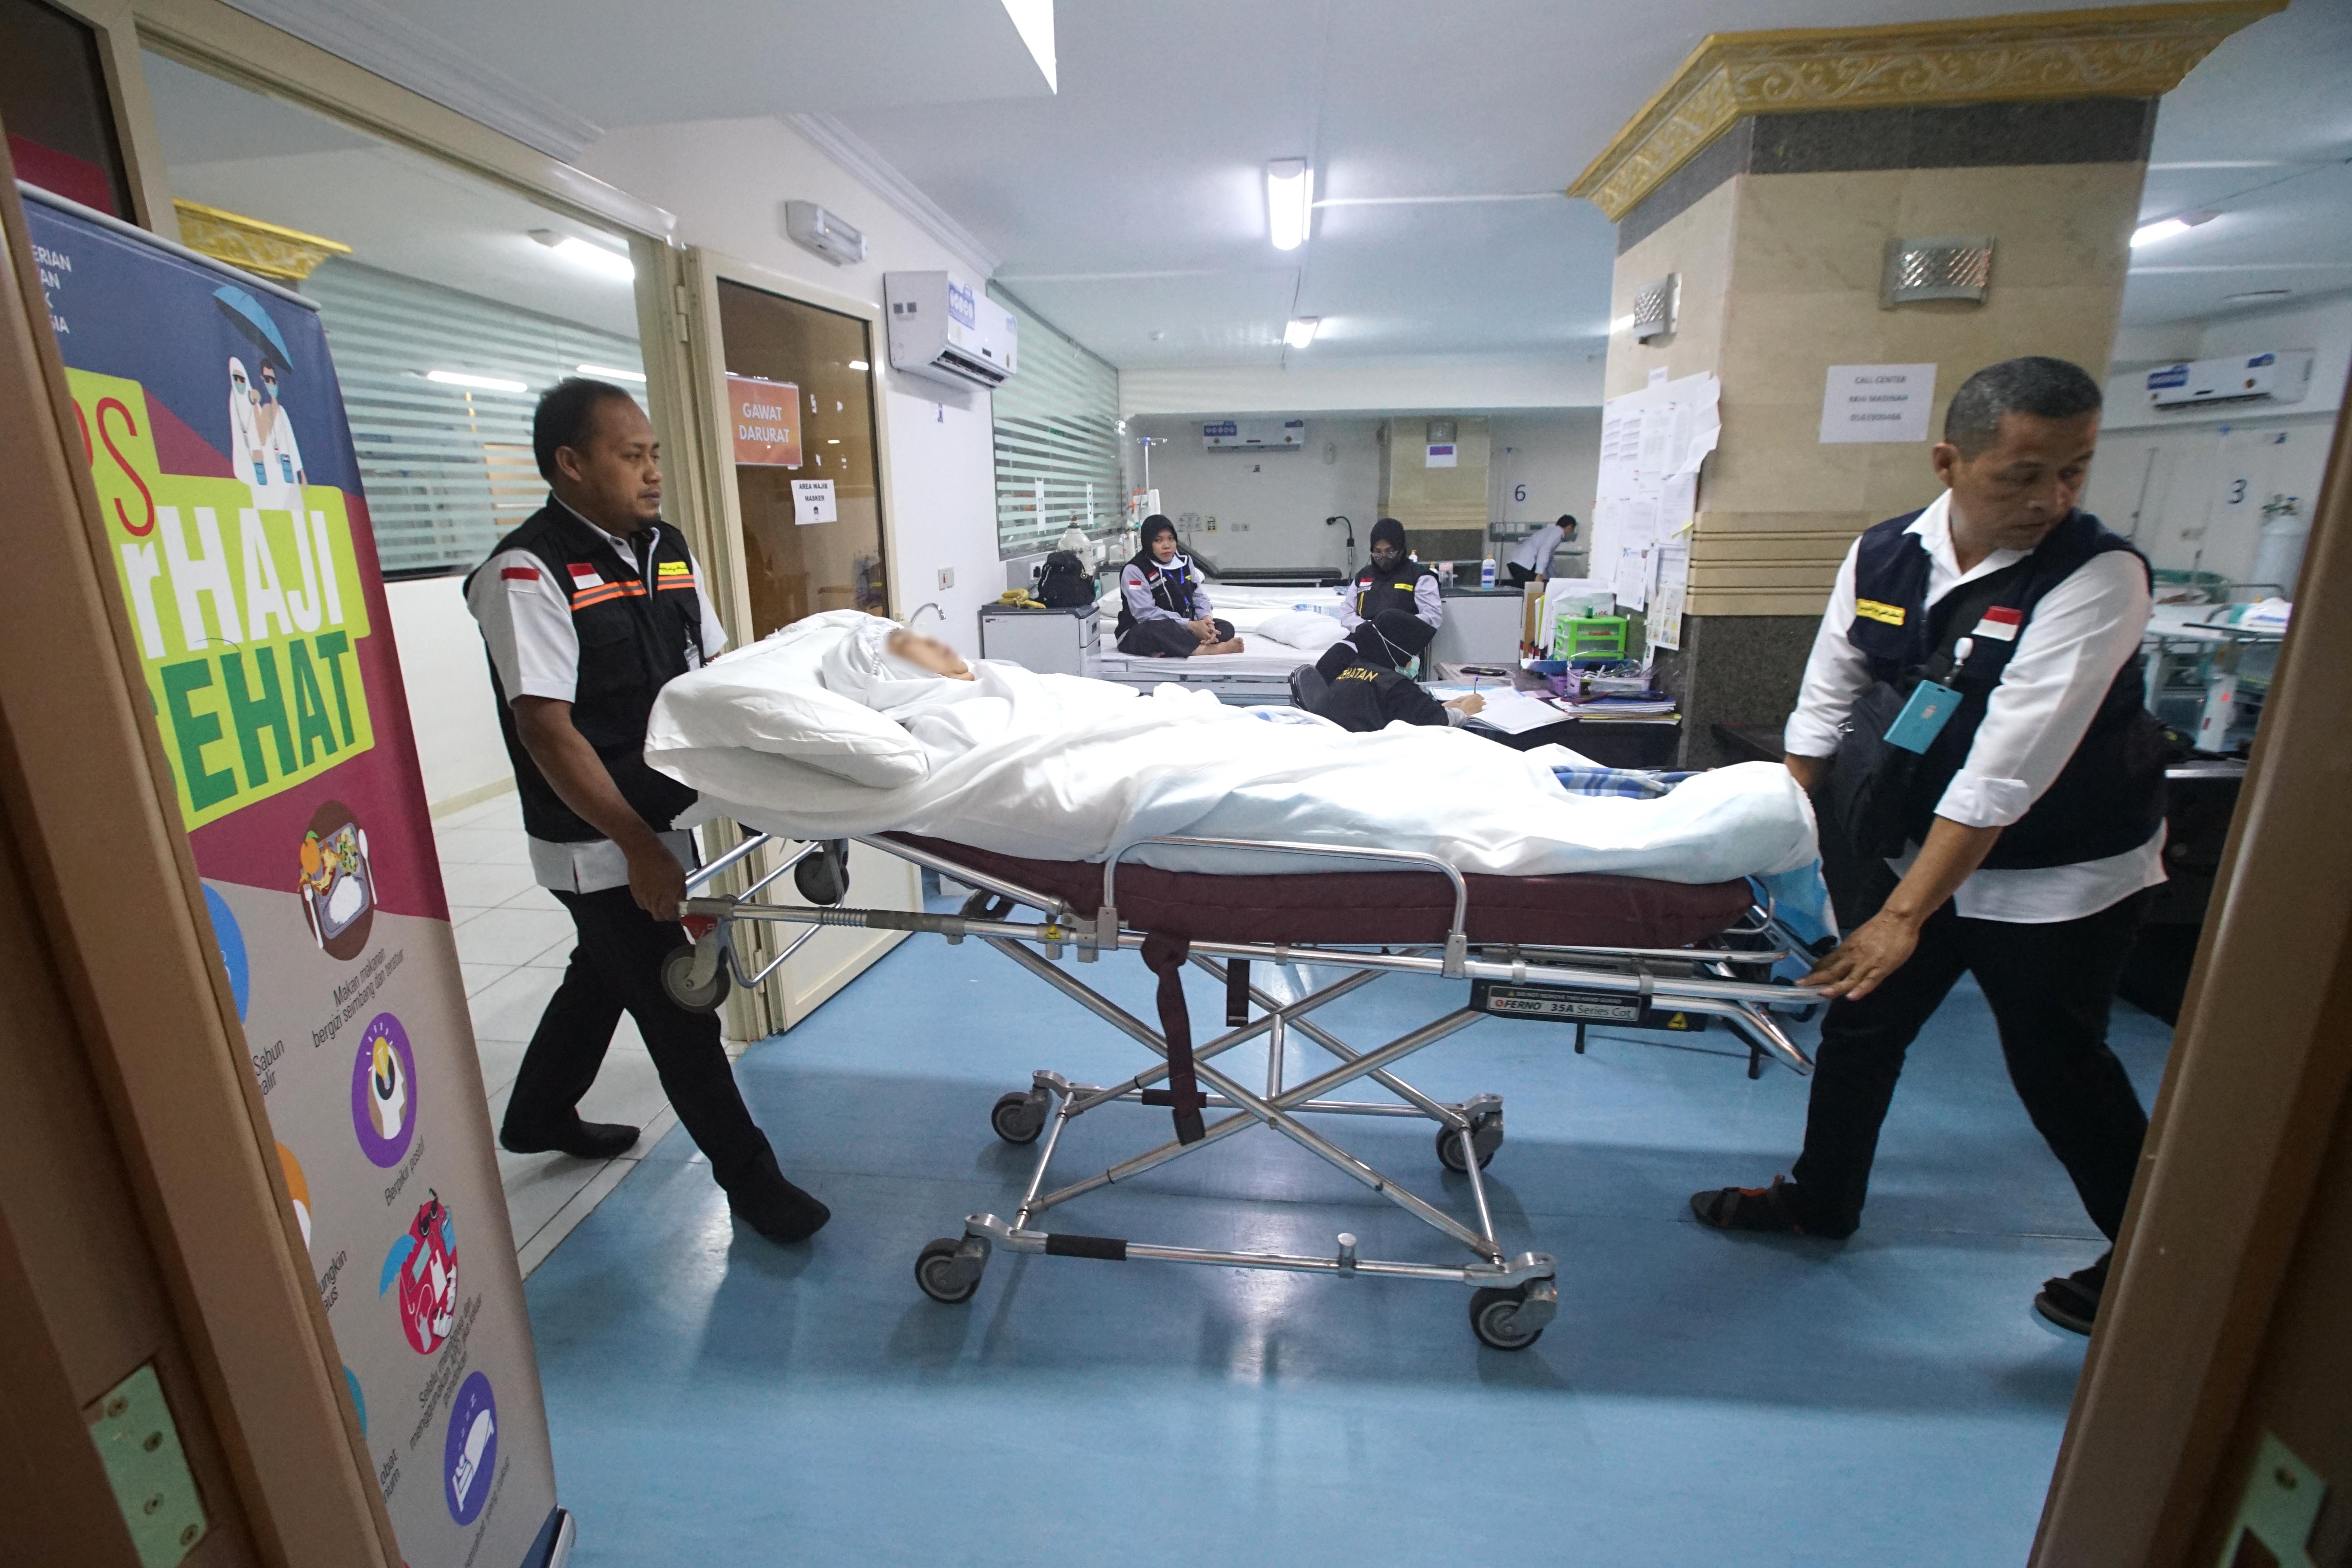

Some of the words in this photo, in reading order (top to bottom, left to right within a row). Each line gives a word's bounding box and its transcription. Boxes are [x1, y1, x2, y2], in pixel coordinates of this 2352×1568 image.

[742, 403, 782, 421] GAWAT
[739, 425, 790, 443] DARURAT
[1088, 491, 1093, 515] 9
[1515, 484, 1526, 501] 6
[2228, 479, 2247, 504] 3
[1038, 497, 1044, 512] 10
[149, 630, 355, 812] EHAT
[333, 976, 359, 1007] Makan
[360, 948, 386, 983] makanan
[312, 1010, 343, 1048] bergizi
[343, 982, 375, 1022] seimbang
[374, 969, 386, 989] dan
[1504, 1000, 1542, 1010] FERNO
[1551, 1003, 1574, 1013] 35A
[1577, 1005, 1609, 1015] Series
[1612, 1008, 1631, 1017] Cot
[253, 1040, 285, 1076] Sabun
[385, 1165, 409, 1207] Berpikir
